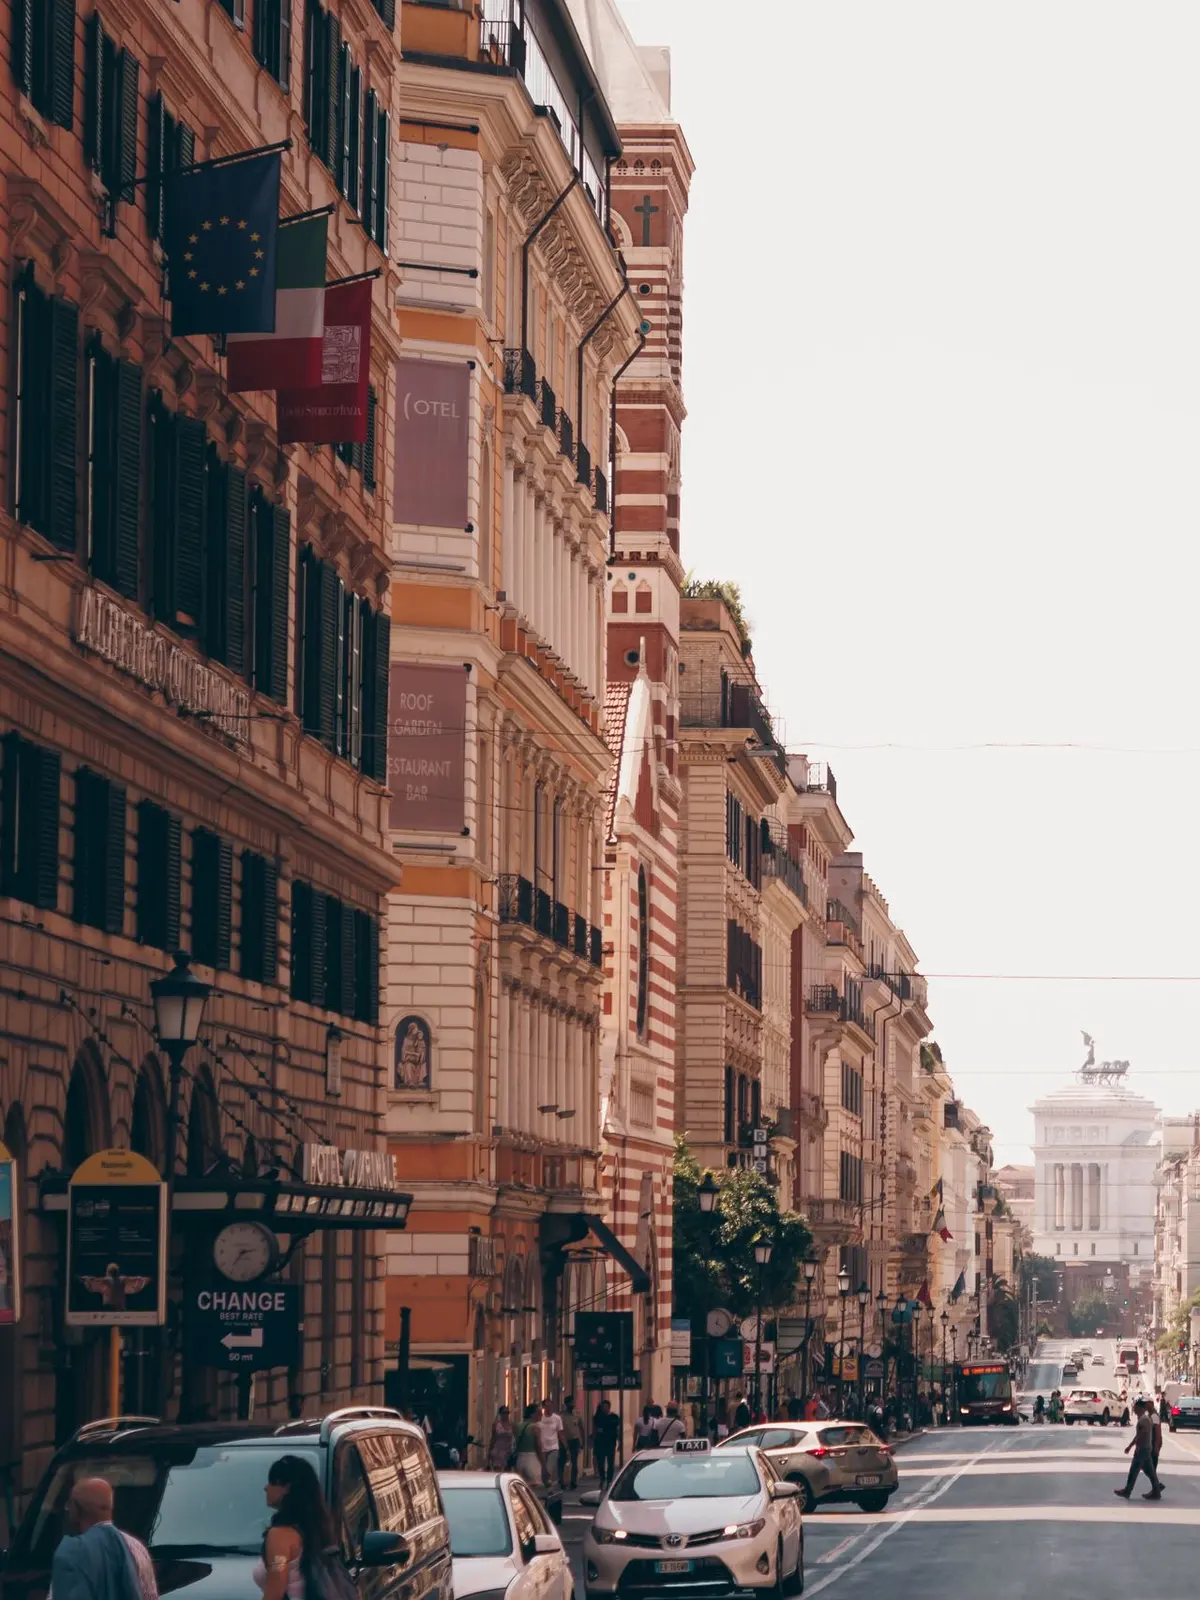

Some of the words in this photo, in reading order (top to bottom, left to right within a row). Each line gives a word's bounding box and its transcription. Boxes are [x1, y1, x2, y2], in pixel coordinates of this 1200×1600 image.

[400, 692, 434, 711] ROOF
[394, 718, 443, 736] GARDEN
[388, 757, 452, 777] ESTAURANT
[406, 784, 428, 801] BAR
[197, 1291, 286, 1311] CHANGE
[220, 1312, 240, 1321] BEST
[242, 1312, 264, 1321] RATE
[228, 1353, 240, 1361] 50
[679, 1440, 704, 1450] TAXI
